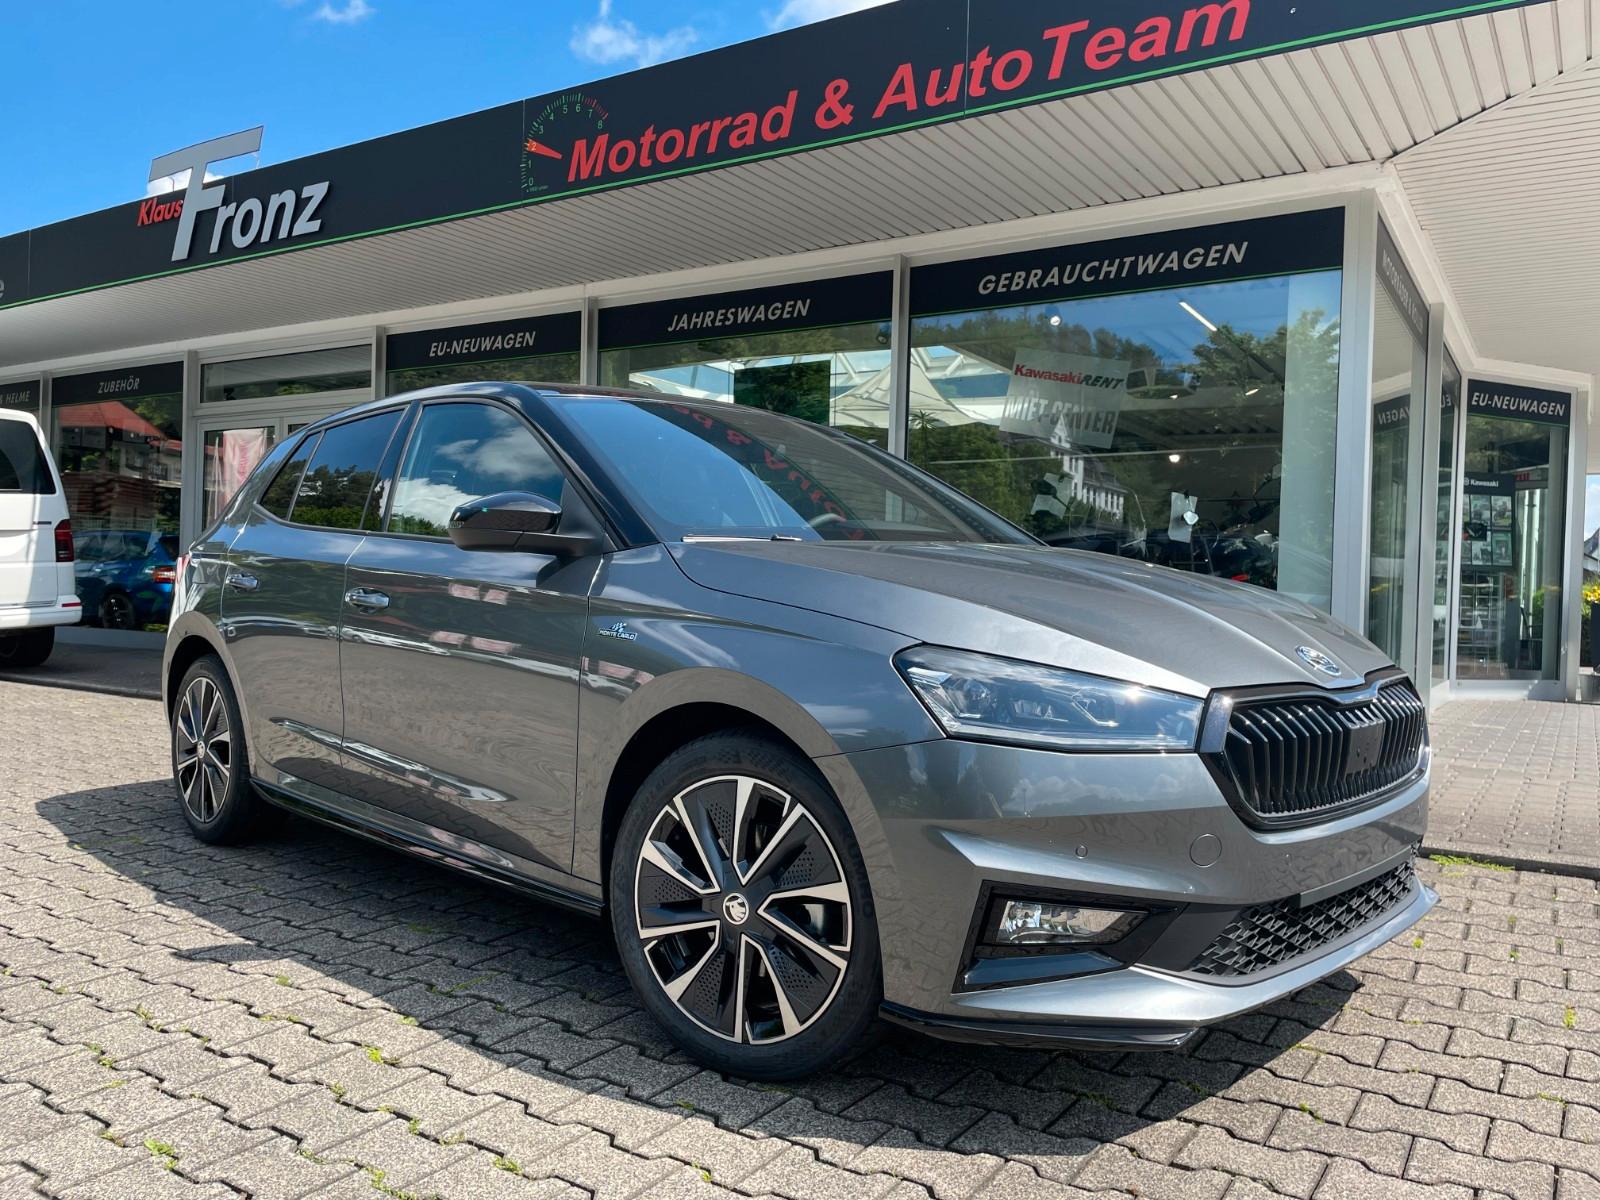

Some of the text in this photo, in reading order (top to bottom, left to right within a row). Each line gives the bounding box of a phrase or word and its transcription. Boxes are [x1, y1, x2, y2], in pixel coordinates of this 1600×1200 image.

[575, 104, 581, 113] 6
[567, 90, 798, 182] Motorrad
[814, 78, 854, 129] &
[149, 125, 330, 262] Fronz
[137, 200, 183, 227] Klaus
[977, 240, 1249, 297] GEBRAUCHTWAGEN
[667, 299, 811, 333] JAHRESWAGEN
[429, 331, 536, 358] EU-NEUWAGEN
[97, 375, 140, 395] ZUBEHÖR
[1471, 391, 1566, 417] EU-NEUWAGEN
[1470, 479, 1499, 488] Kawasaki
